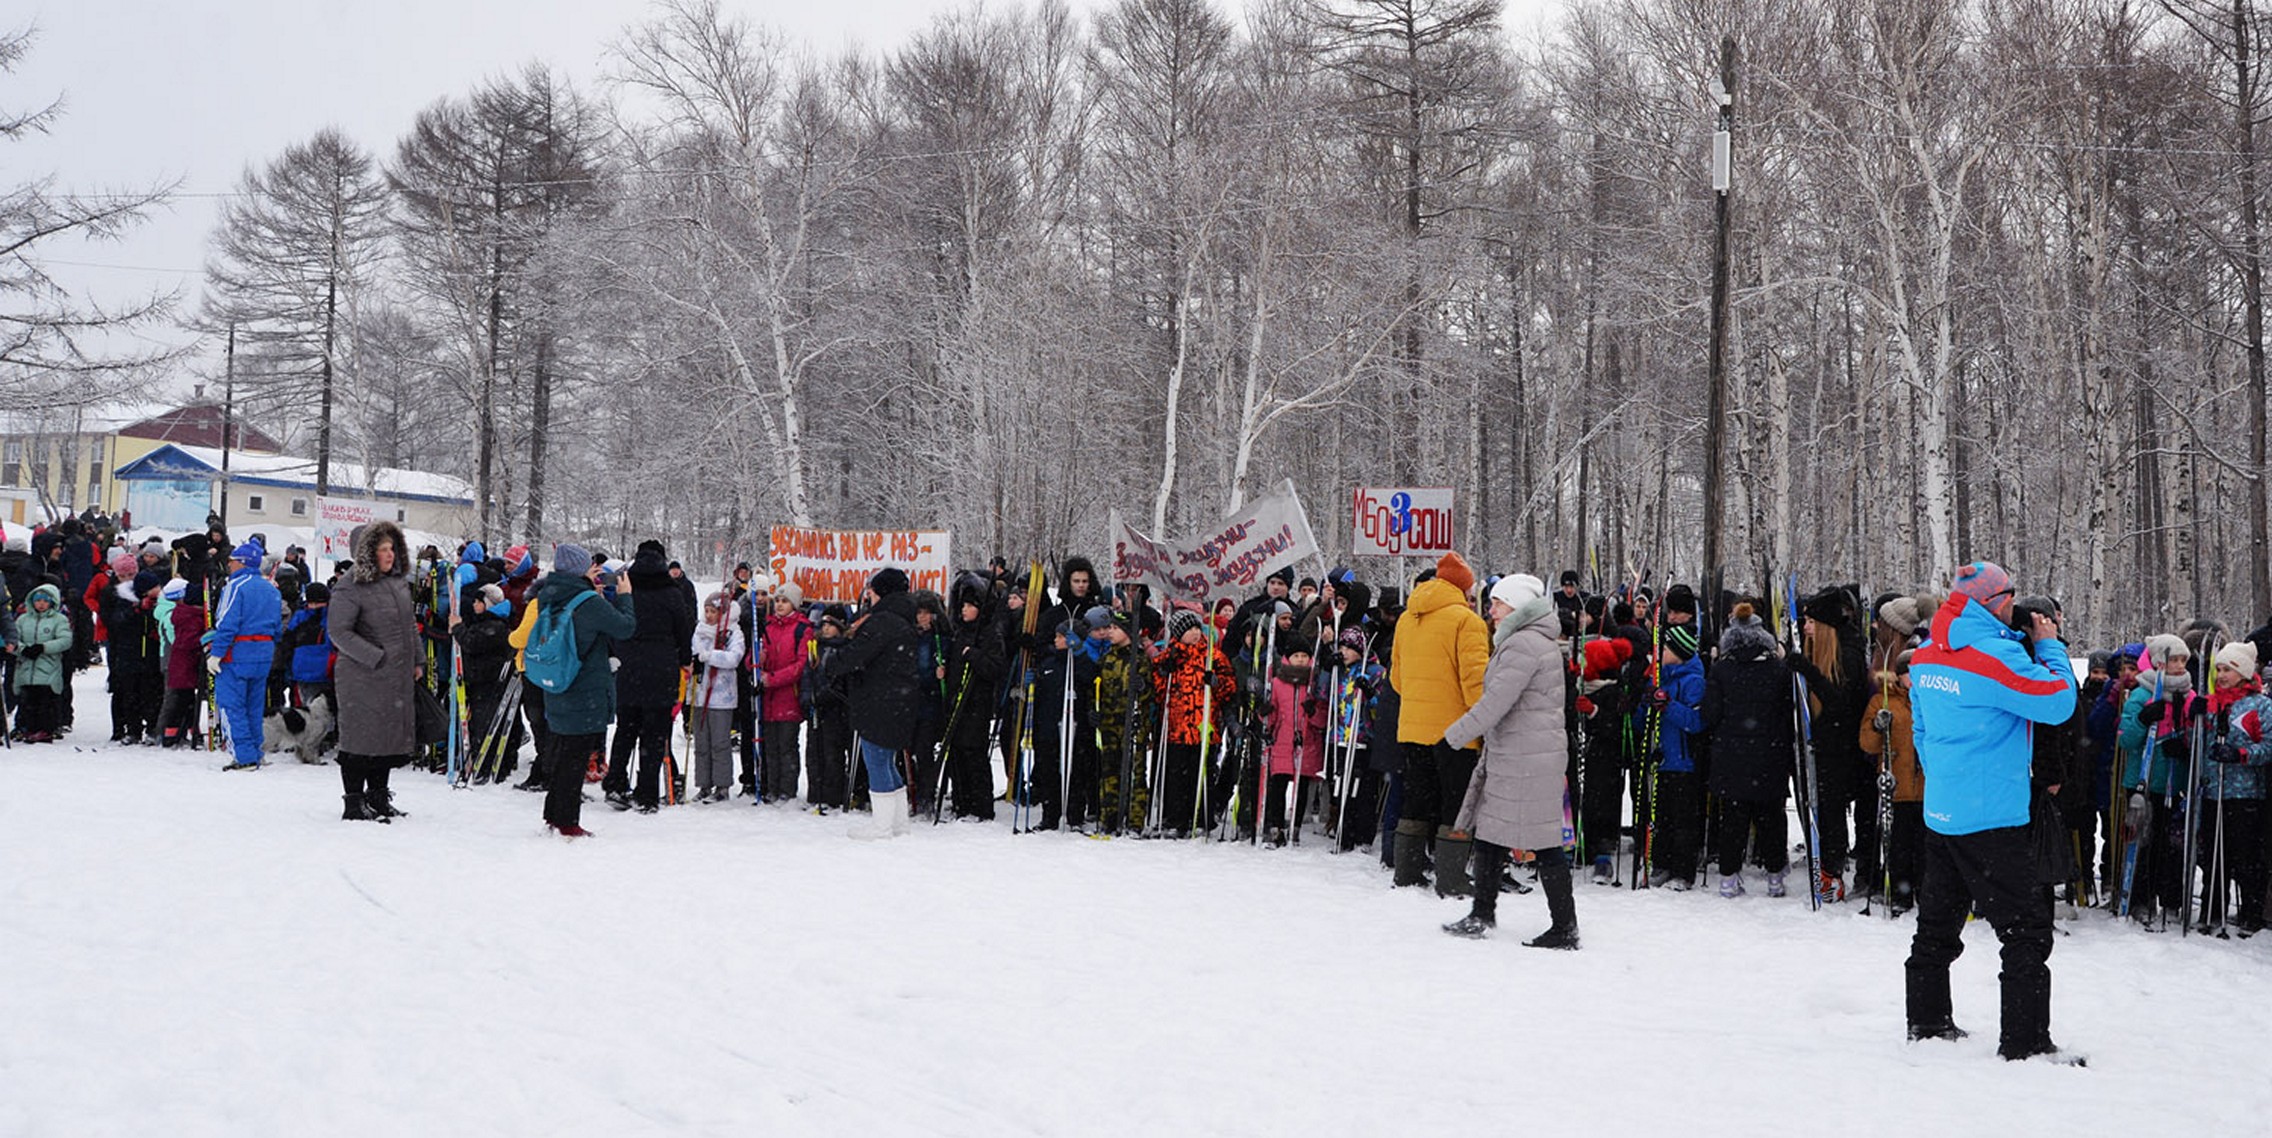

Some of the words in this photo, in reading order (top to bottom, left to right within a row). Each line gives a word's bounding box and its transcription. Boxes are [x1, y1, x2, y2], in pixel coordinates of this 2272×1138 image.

[1353, 487, 1401, 554] МБОУ
[1391, 491, 1412, 534] 3
[1407, 507, 1452, 550] СОШ
[839, 532, 858, 562] ВЫ
[863, 531, 885, 562] НЕ
[1213, 523, 1296, 586] жизни!
[1919, 674, 1961, 696] RUSSIA
